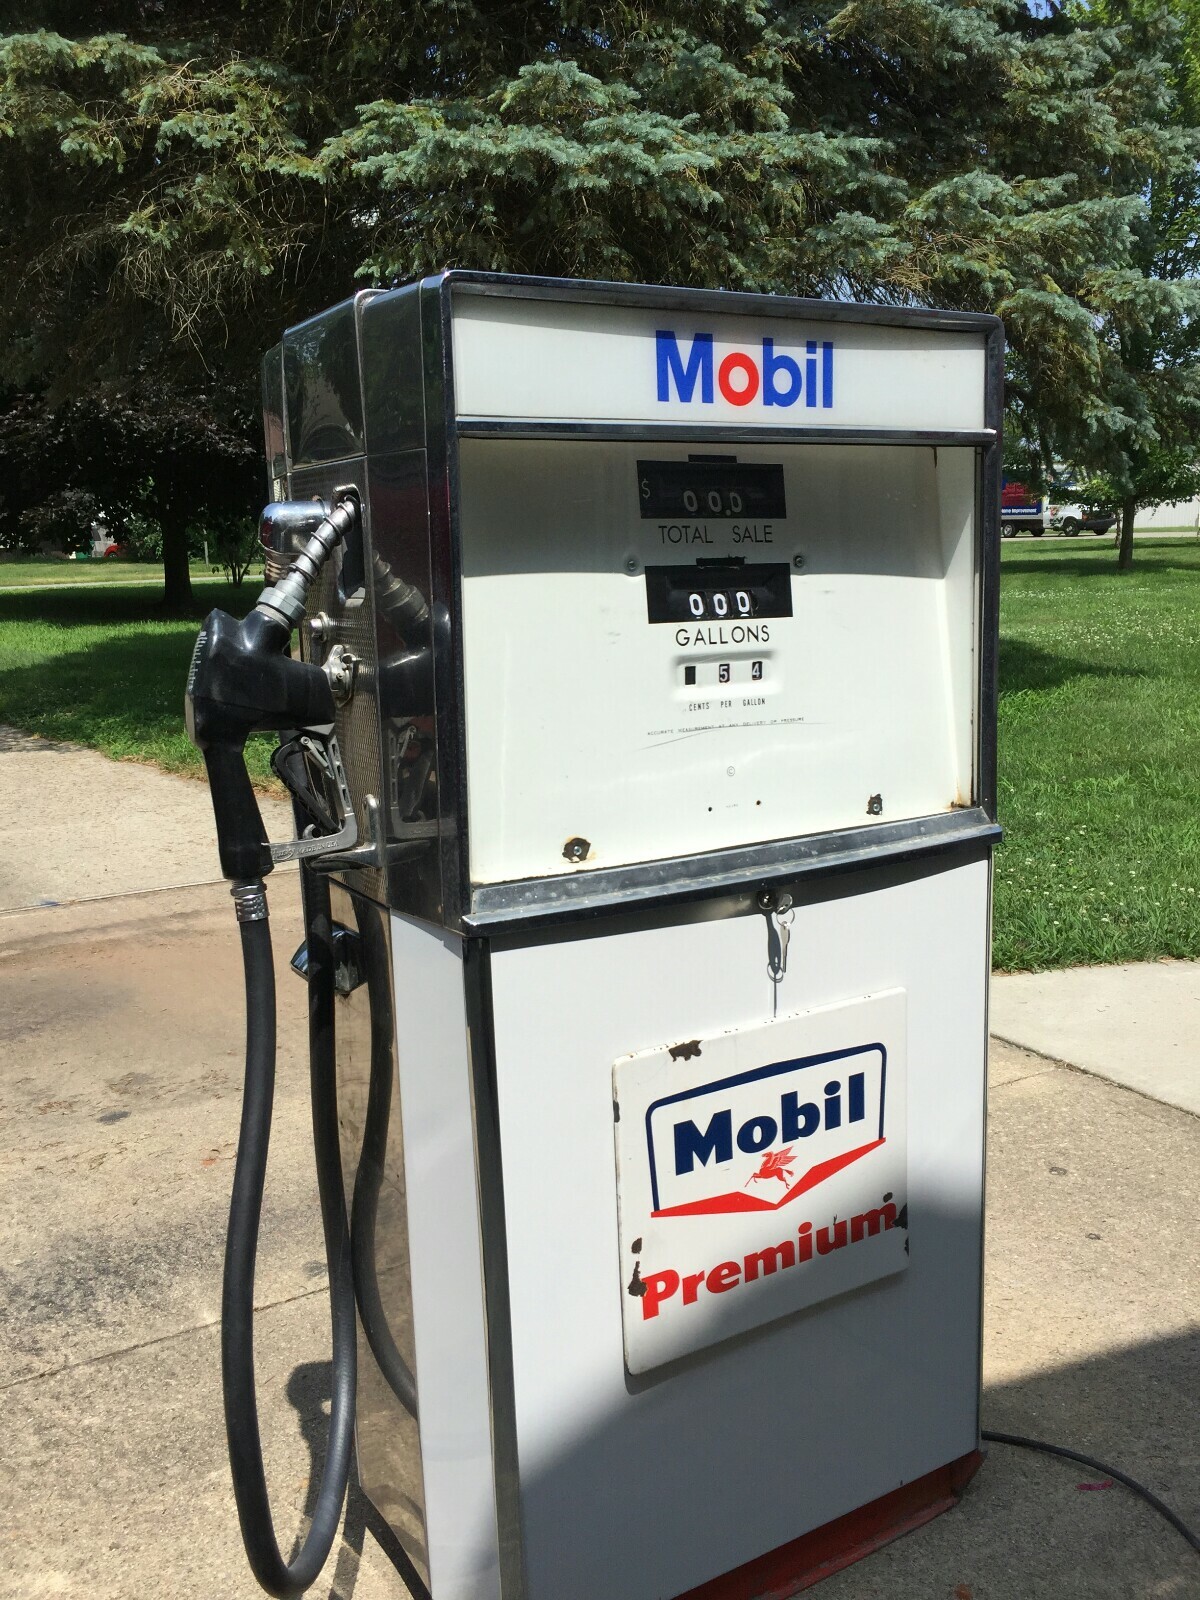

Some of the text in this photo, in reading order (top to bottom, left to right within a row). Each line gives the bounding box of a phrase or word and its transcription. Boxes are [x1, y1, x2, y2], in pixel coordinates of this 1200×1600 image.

[655, 330, 834, 409] Mobil
[658, 524, 774, 544] TOTAL SALE
[675, 624, 771, 647] GALLONS
[688, 698, 766, 712] CENTS PER GALLON
[673, 1071, 865, 1177] Mobil
[641, 1200, 897, 1321] Premium
